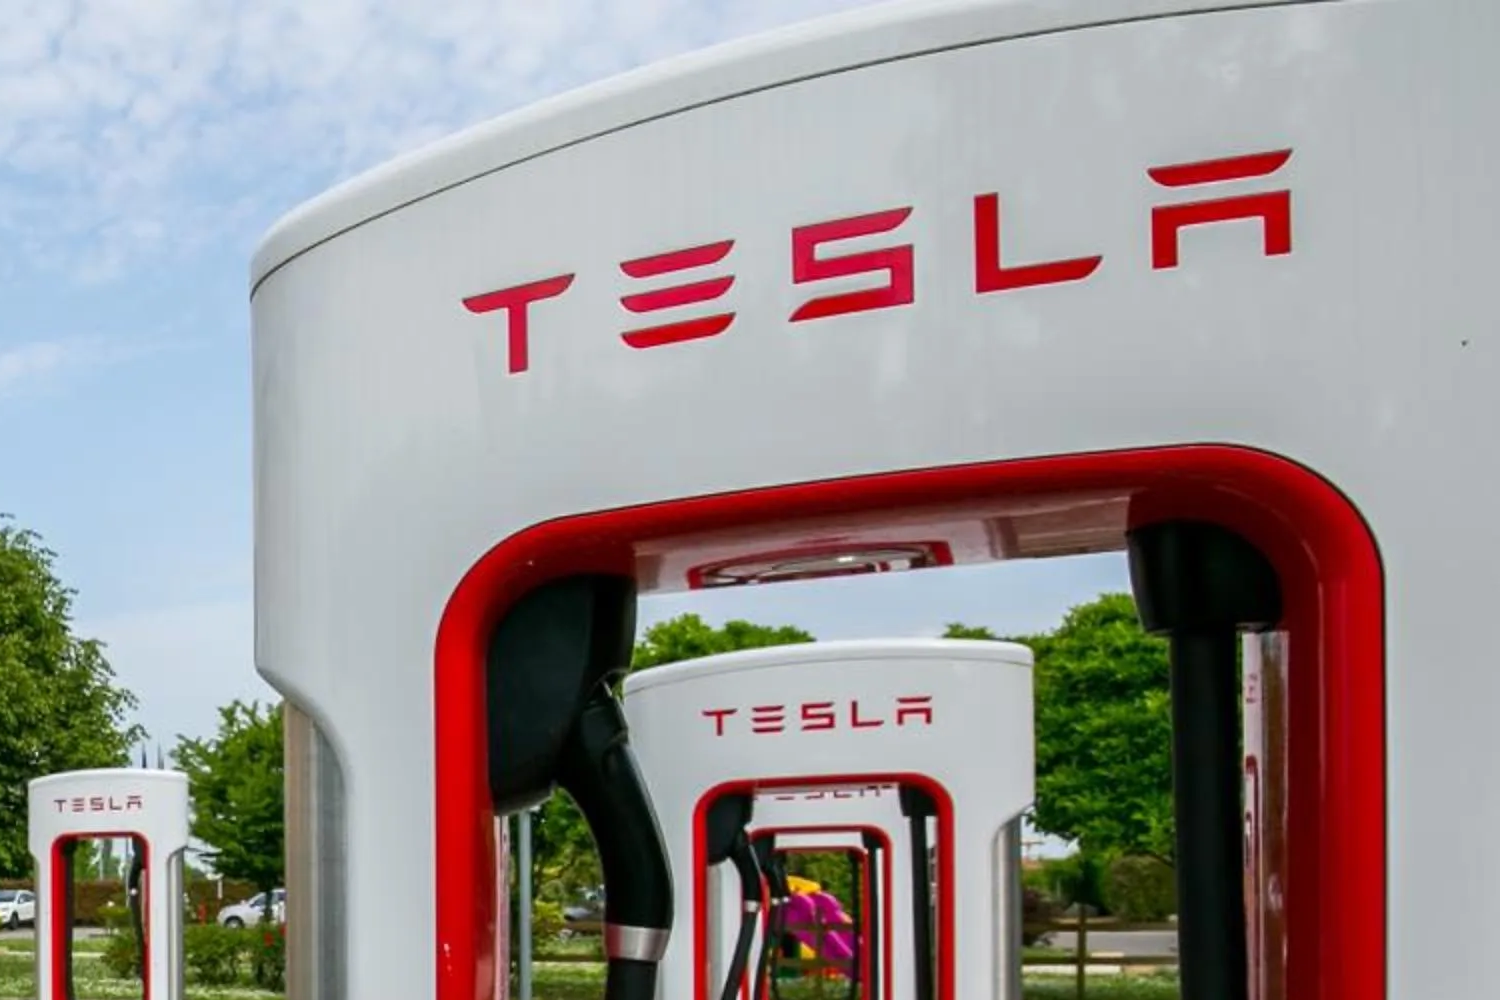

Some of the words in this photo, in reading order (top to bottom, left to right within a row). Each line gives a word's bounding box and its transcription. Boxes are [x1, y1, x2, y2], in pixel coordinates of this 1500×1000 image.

[462, 147, 1293, 375] TESLA
[702, 695, 933, 737] TESLA
[53, 795, 142, 814] TESLA
